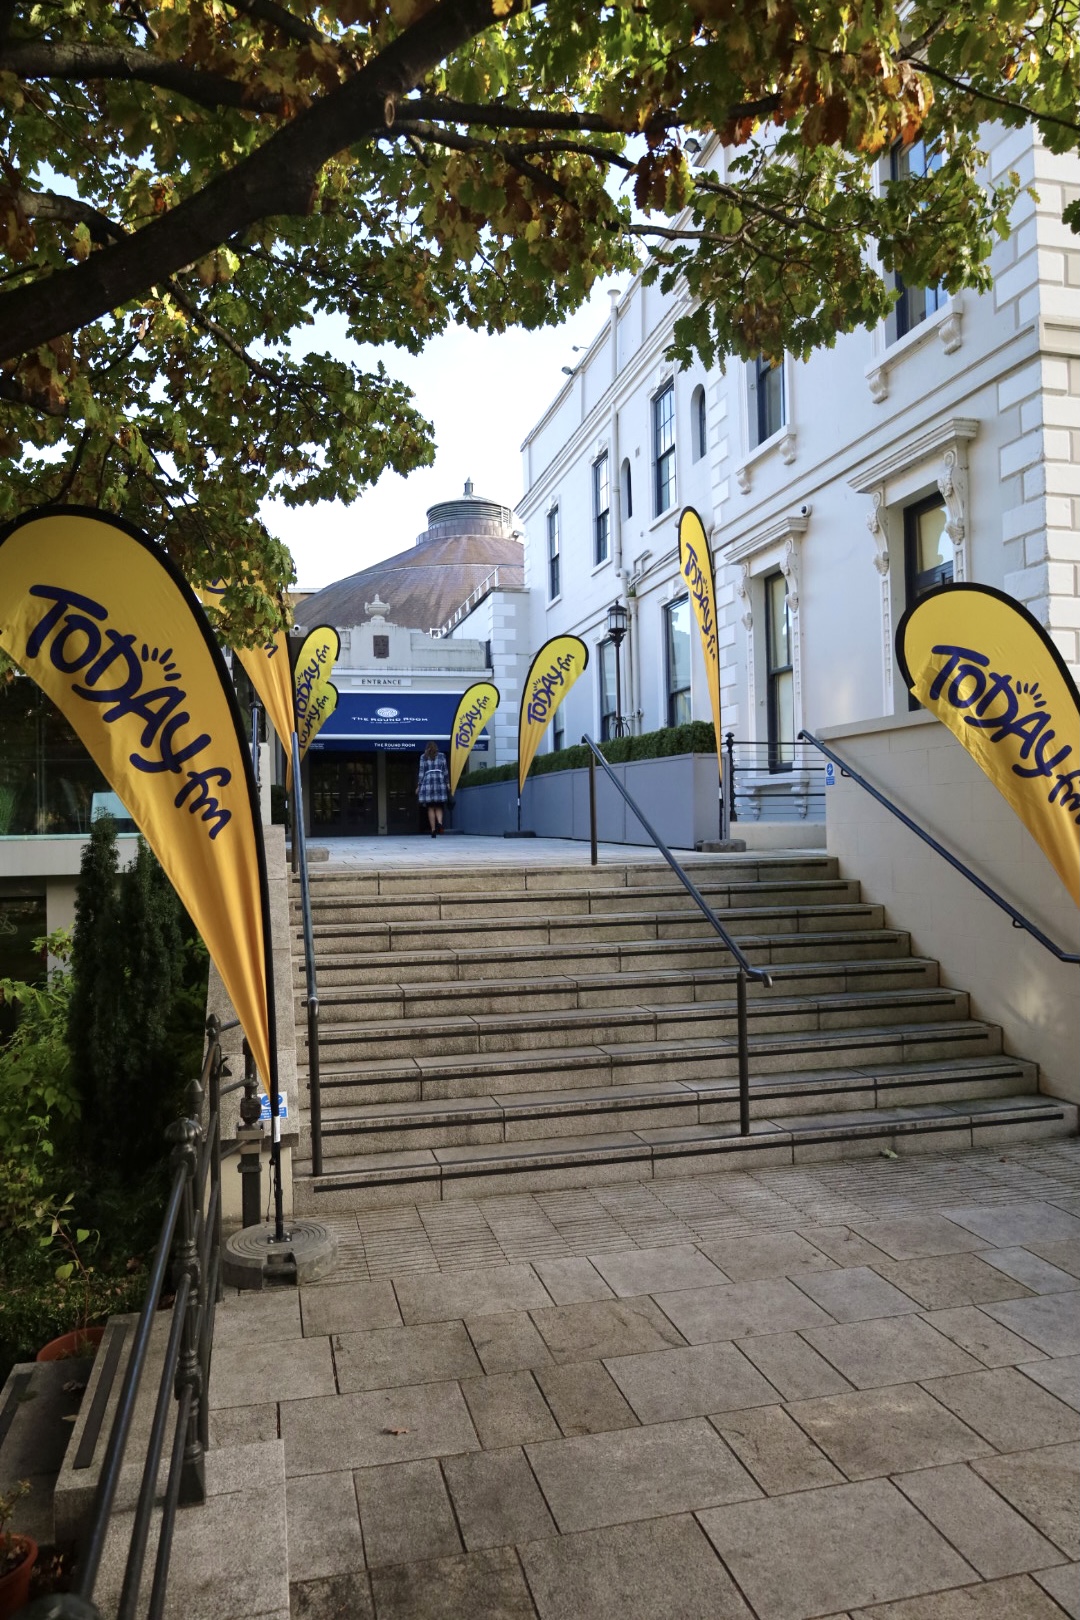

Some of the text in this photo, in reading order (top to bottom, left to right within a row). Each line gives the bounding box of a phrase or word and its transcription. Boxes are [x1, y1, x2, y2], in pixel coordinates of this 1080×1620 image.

[316, 644, 330, 664] fm
[528, 653, 575, 725] TODAY fm
[26, 584, 232, 840] TODAY fm
[455, 704, 482, 749] TODAY
[476, 695, 490, 709] fm
[929, 645, 1073, 778] TODAY
